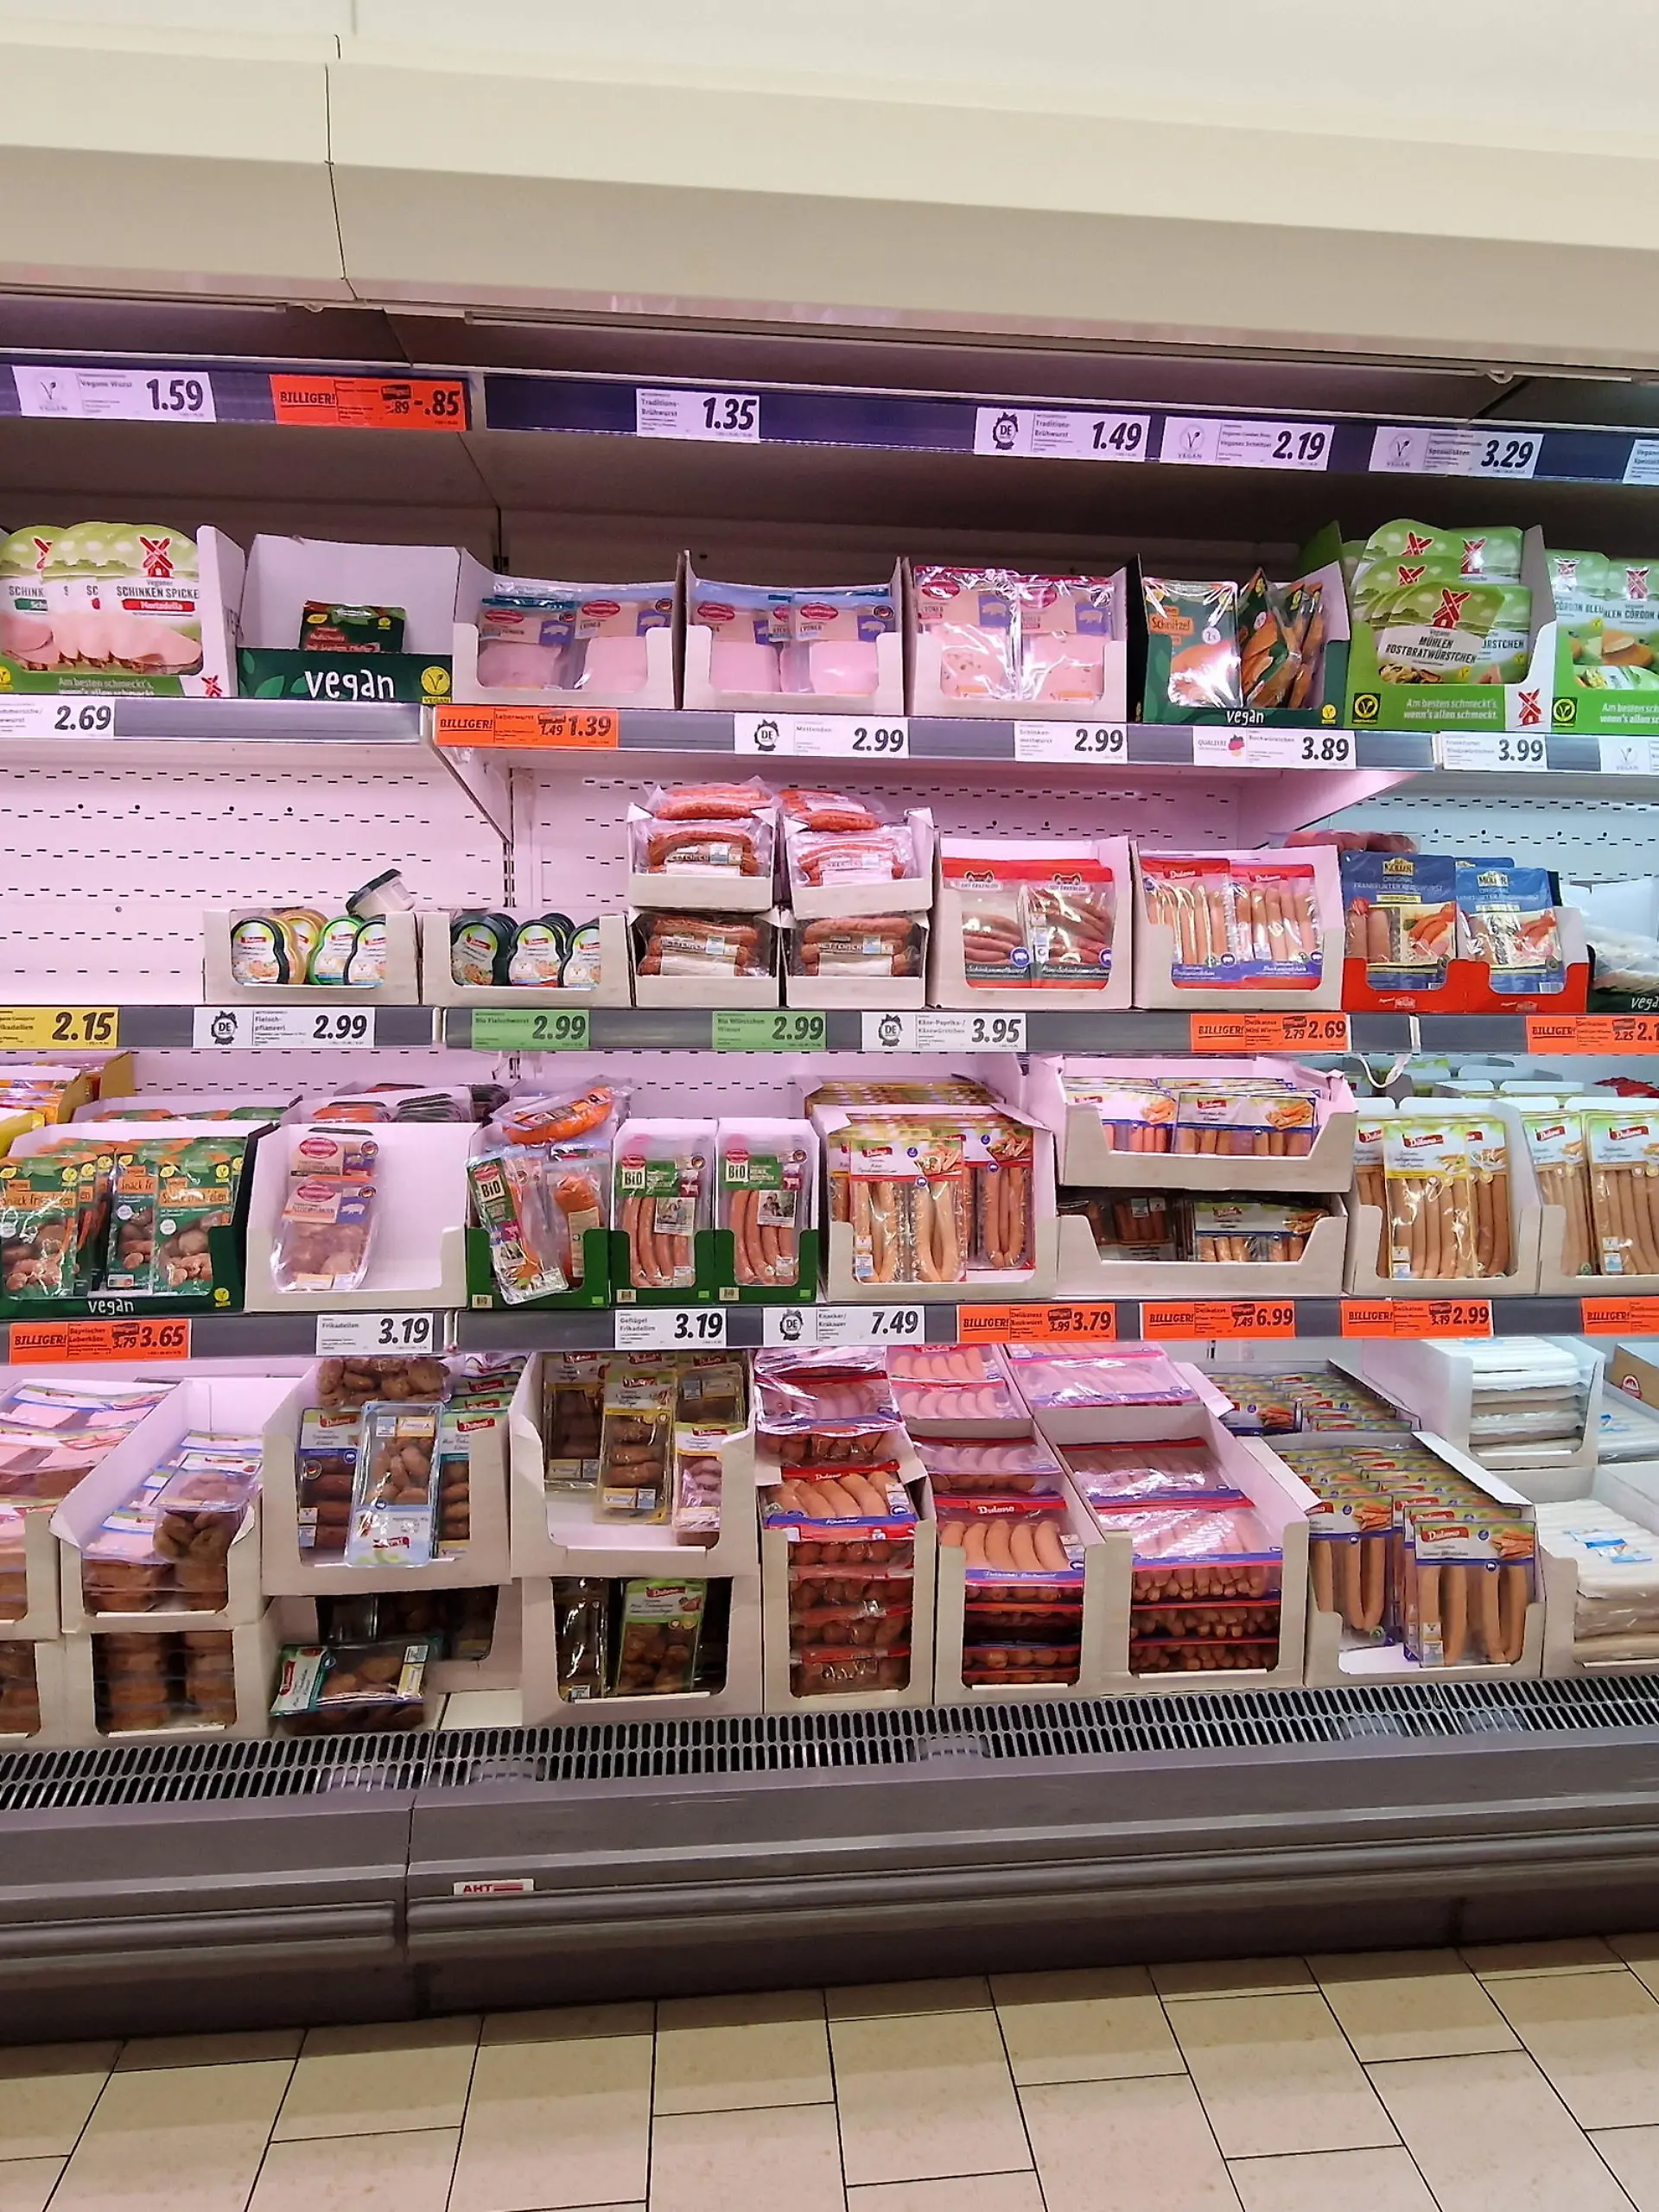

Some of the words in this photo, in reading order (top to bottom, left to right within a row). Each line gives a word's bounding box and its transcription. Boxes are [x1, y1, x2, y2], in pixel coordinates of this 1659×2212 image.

[147, 378, 204, 411] 1.59
[280, 391, 335, 405] BILLIGER!
[703, 397, 757, 430] 1.35
[1092, 421, 1142, 451] 1.49
[1272, 430, 1325, 462] 2.19
[1480, 439, 1535, 469] 3.29
[116, 585, 163, 598] SCHINKEN
[1418, 636, 1454, 650] MÜHLEN
[304, 669, 396, 701] vegan
[54, 704, 112, 731] 2.69
[440, 717, 493, 730] BILLIGER!
[569, 715, 612, 737] 1.39
[1225, 709, 1265, 726] vegan
[851, 727, 905, 753] 2.99
[1073, 728, 1124, 753] 2.99
[1301, 736, 1350, 761] 3.89
[1497, 738, 1544, 762] 3.99
[52, 1011, 115, 1041] 2.15
[218, 1021, 232, 1032] DE
[313, 1014, 367, 1039] 2.99
[532, 1014, 586, 1040] 2.99
[772, 1015, 824, 1040] 2.99
[971, 1018, 1022, 1043] 3.95
[1198, 1026, 1244, 1035] BILLIGER!
[1307, 1020, 1347, 1039] 2.69
[1532, 1027, 1576, 1035] BILLIGER!
[1614, 1031, 1634, 1041] 2.25
[1409, 1136, 1438, 1147] Dulano
[1617, 1128, 1643, 1139] Dulano
[87, 1297, 135, 1316] vegan
[1452, 1306, 1490, 1325] 2.99
[674, 1313, 723, 1339] 3.19
[786, 1319, 798, 1329] DE
[871, 1310, 918, 1335] 7.49
[963, 1319, 1009, 1329] BILLIGER!
[1073, 1310, 1112, 1332] 3.79
[1149, 1313, 1194, 1324] BILLIGER!
[1256, 1308, 1294, 1326] 6.99
[1348, 1312, 1393, 1321] BILLIGER!
[1586, 1312, 1630, 1321] BILLIGER!
[140, 1325, 186, 1349] 3.65
[378, 1317, 430, 1344] 3.19
[14, 1335, 67, 1347] BILLIGER!
[815, 1472, 842, 1481] Dulano
[976, 1505, 1014, 1515] Dulano
[1427, 1529, 1460, 1541] Dulano
[463, 1884, 493, 1893] AHT
